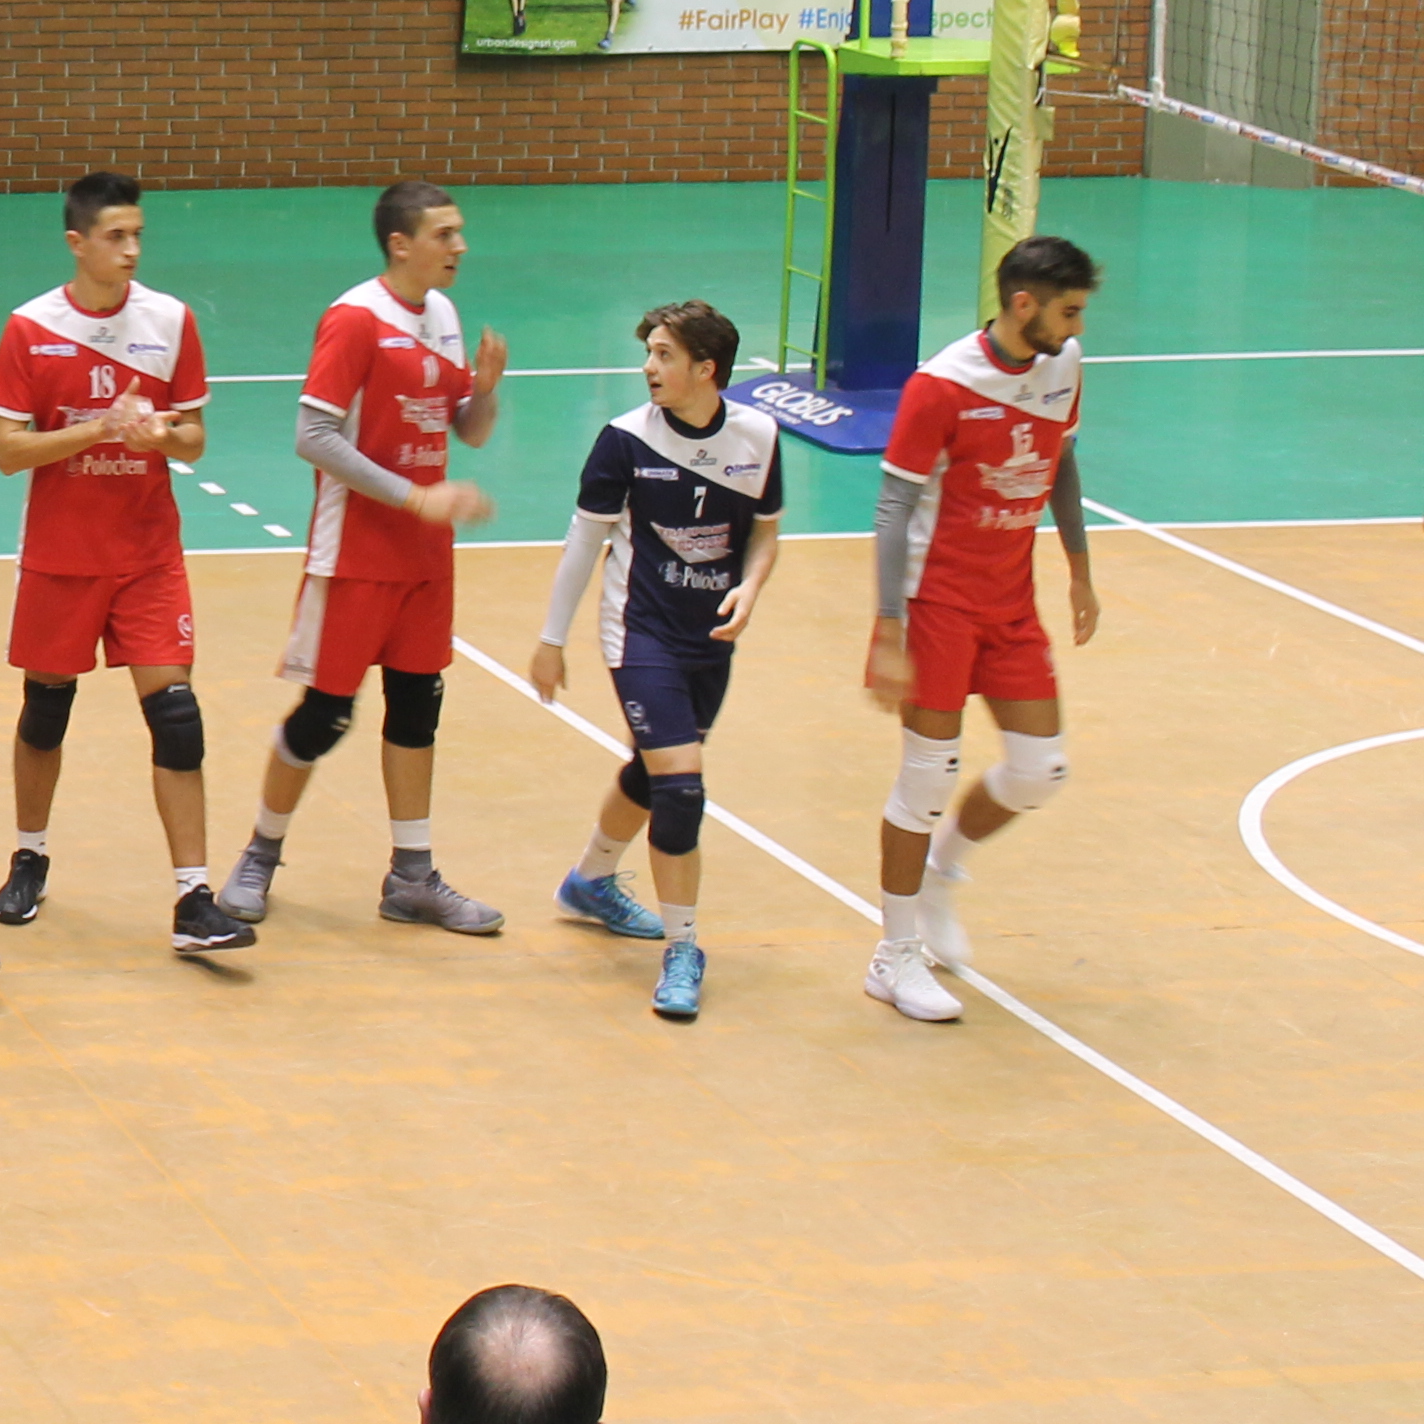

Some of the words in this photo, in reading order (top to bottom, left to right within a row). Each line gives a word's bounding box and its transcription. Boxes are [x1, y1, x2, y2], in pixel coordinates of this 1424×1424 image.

[679, 8, 790, 34] #FairPlay
[89, 364, 117, 400] 18
[751, 380, 854, 426] GLOBUS
[692, 486, 707, 519] 7
